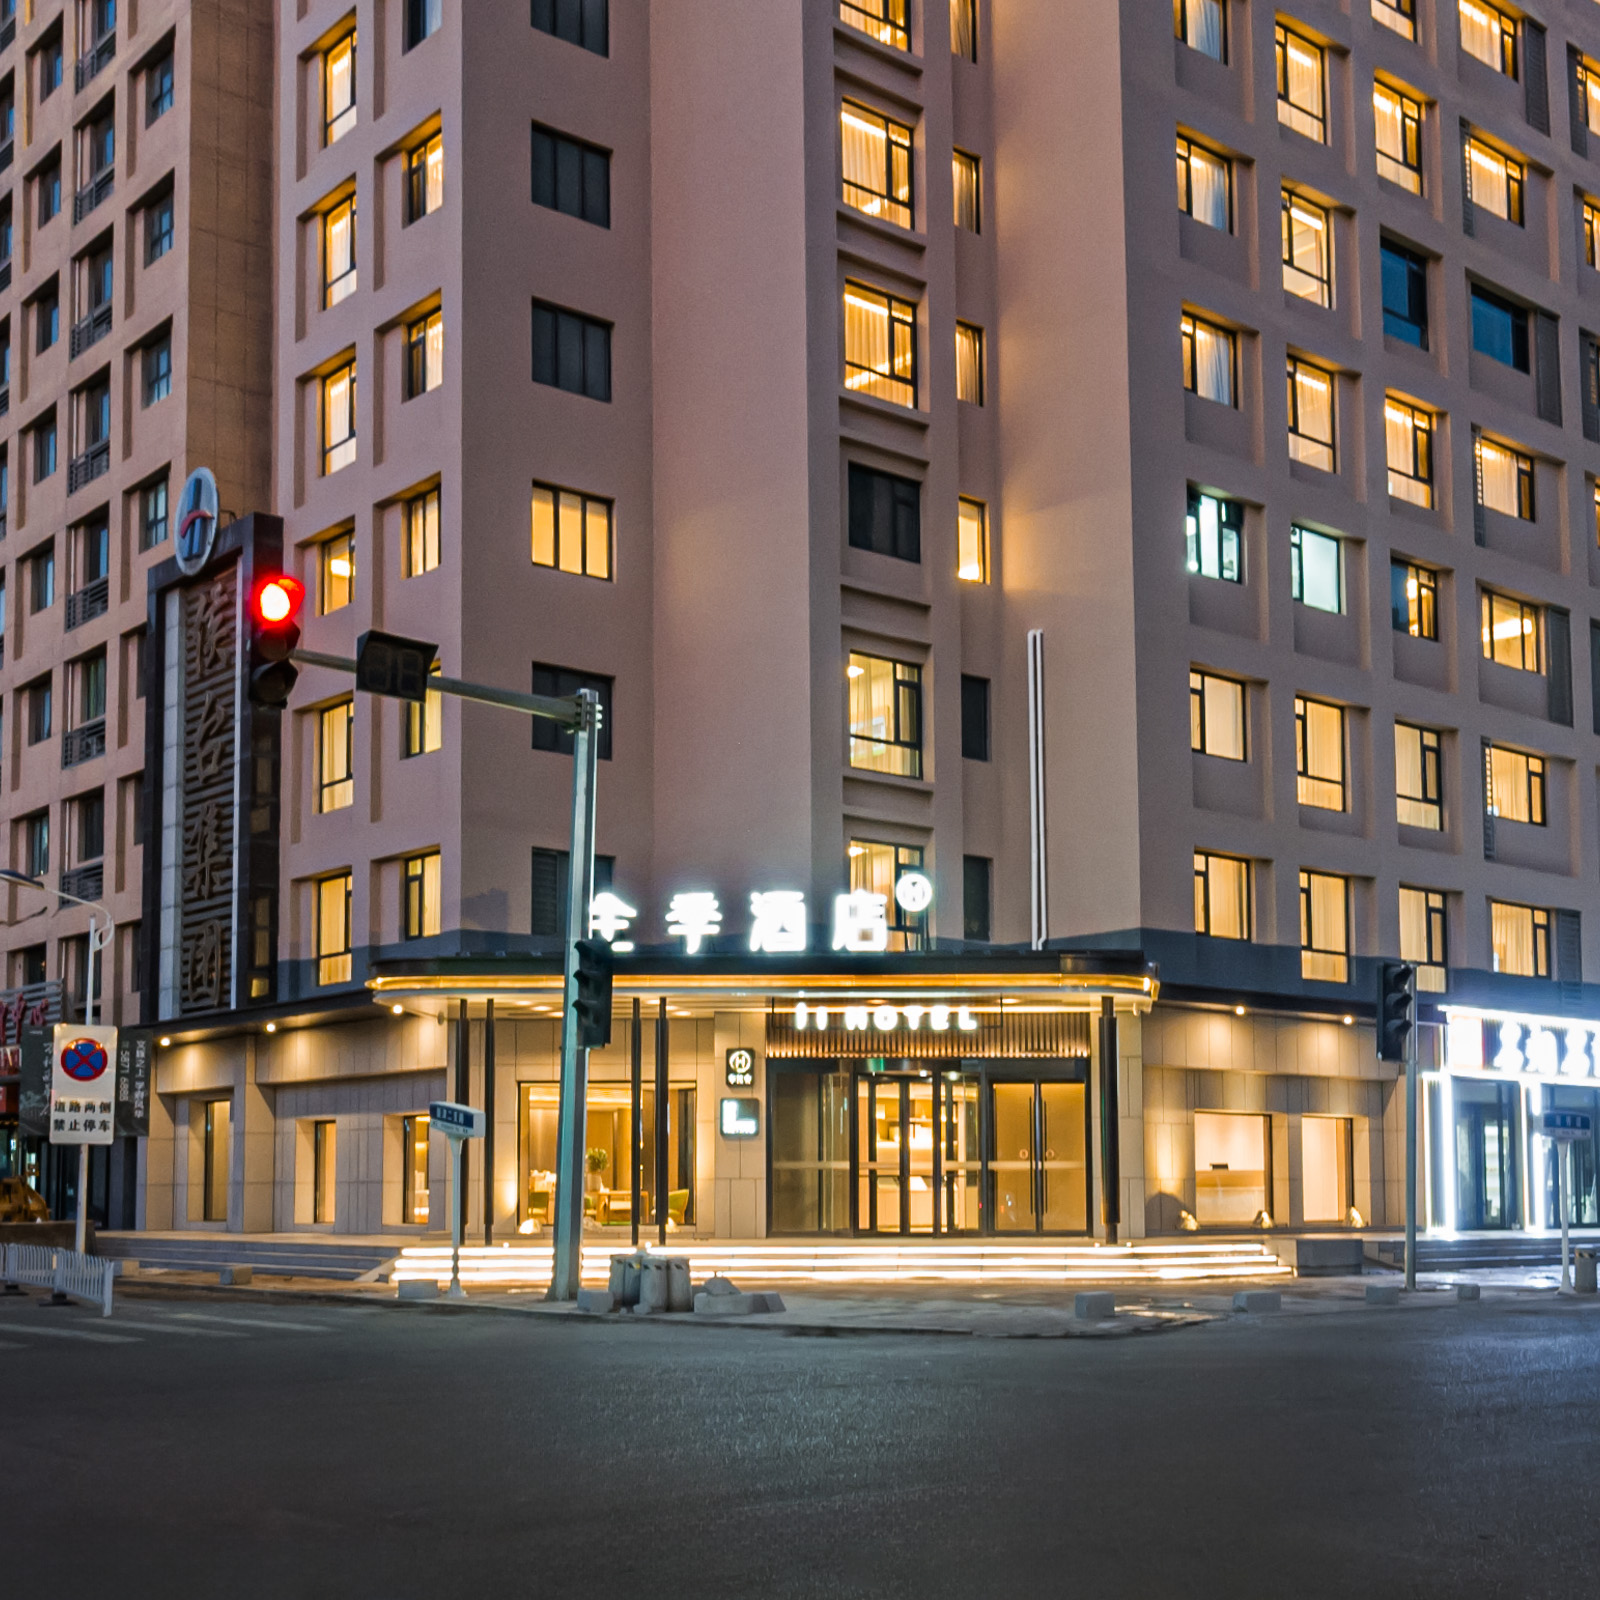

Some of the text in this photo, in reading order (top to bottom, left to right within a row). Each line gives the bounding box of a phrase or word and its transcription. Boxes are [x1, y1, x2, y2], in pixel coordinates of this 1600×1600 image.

[845, 1004, 977, 1031] HOTEL
[54, 1101, 112, 1114] 道路两侧
[54, 1119, 111, 1131] 禁止停车
